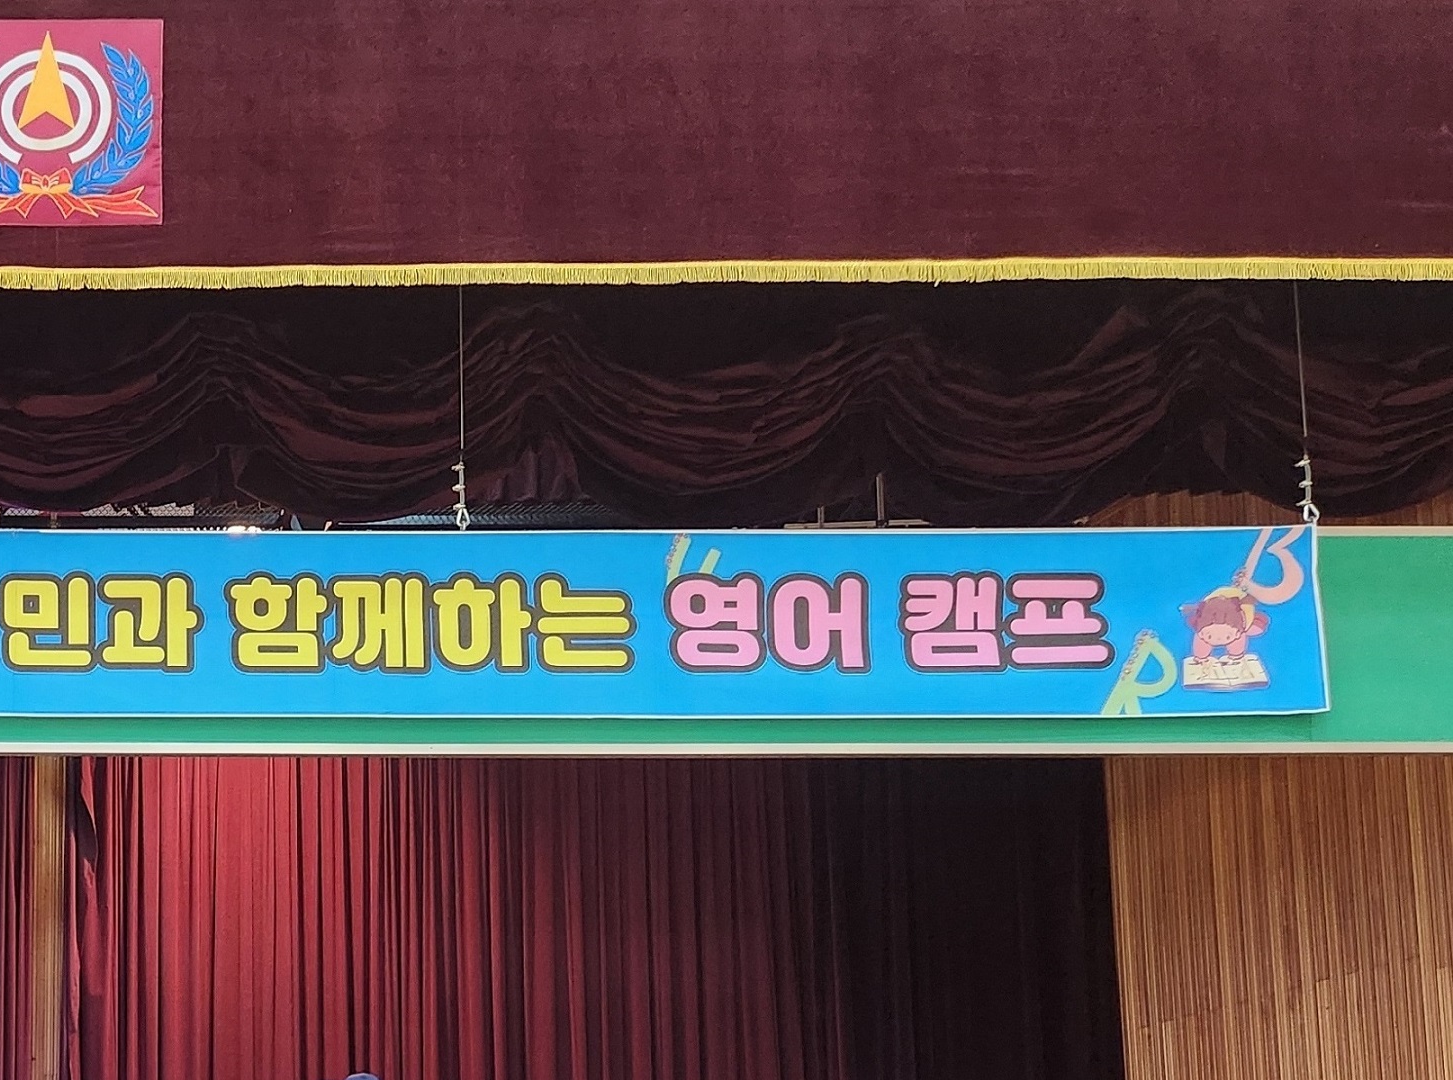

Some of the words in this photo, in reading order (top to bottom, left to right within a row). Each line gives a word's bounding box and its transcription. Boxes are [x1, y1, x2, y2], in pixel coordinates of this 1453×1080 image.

[226, 572, 635, 673] 함께하는
[666, 572, 871, 673] 영어
[899, 572, 1114, 673] 캠프
